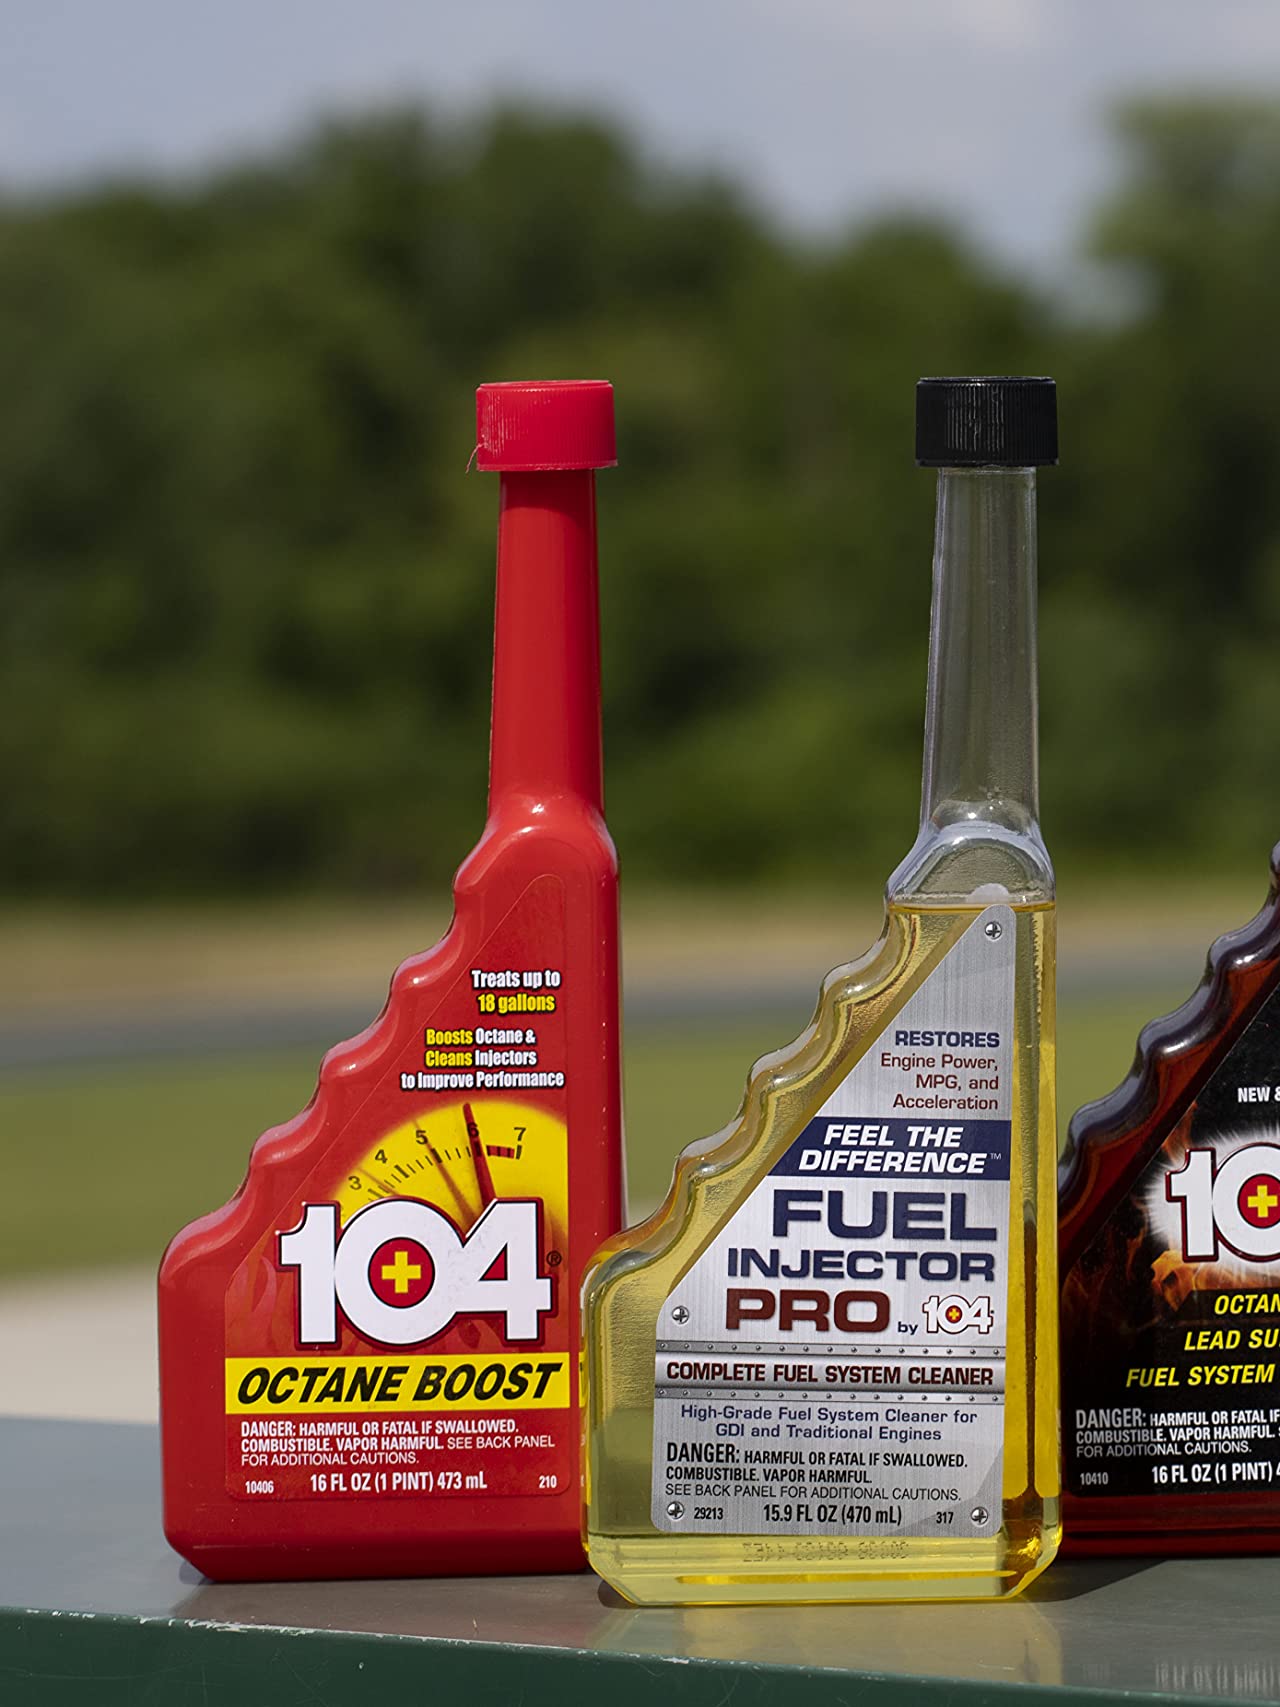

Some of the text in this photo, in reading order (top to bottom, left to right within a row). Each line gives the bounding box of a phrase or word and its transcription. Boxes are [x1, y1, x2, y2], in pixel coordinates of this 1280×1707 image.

[471, 970, 561, 990] Treats up to
[477, 994, 556, 1014] 18 gallons
[426, 1028, 536, 1045] Boosts Octane &
[895, 1030, 1000, 1048] RESTORES
[425, 1050, 537, 1067] Cleans Injectors
[881, 1053, 999, 1071] Engine Power,
[401, 1071, 565, 1090] to Improve Performance
[916, 1075, 999, 1091] MPG, and
[893, 1095, 998, 1110] Acceleration
[1237, 1087, 1271, 1102] NEW
[823, 1124, 964, 1147] FEEL THE
[348, 1122, 527, 1190] 3 4 5 6 7
[772, 1188, 997, 1241] FUEL
[727, 1247, 996, 1282] INJECTOR
[725, 1288, 891, 1333] PRO
[897, 1321, 919, 1336] by
[1184, 1330, 1240, 1351] LEAD
[237, 1362, 563, 1404] OCTANE BOOST
[666, 1361, 994, 1386] COMPLETE FUEL SYSTEM CLEANER
[1125, 1367, 1180, 1388] FUEL
[1187, 1364, 1276, 1386] SYSTEM
[681, 1404, 978, 1424] High-Grade Fuel System Cleaner for
[1076, 1408, 1147, 1429] DANGER:
[1150, 1411, 1210, 1427] HARMFUL
[1211, 1411, 1229, 1425] OR
[1231, 1410, 1267, 1425] FATAL
[1269, 1409, 1280, 1423] IF
[241, 1418, 519, 1437] DANGER: HARMFUL OR FATAL IF SWALLOWED.
[715, 1423, 942, 1443] GDI and Traditional Engines
[1076, 1428, 1167, 1444] COMBUSTIBLE.
[1169, 1427, 1211, 1441] VAPOR
[1213, 1425, 1276, 1440] HARMFUL.
[241, 1434, 556, 1453] COMBUSTIBLE. VAPOR HARMFUL. SEE BACK PANEL
[1076, 1439, 1252, 1458] FOR ADDITIONAL CAUTIONS.
[241, 1451, 420, 1466] FOR ADDITIONAL CAUTIONS.
[666, 1442, 968, 1468] DANGER: HARMFUL OR FATAL IF SWALLOWED.
[244, 1471, 557, 1494] 10406 16 FL OZ (1 PINT) 473 mL 210
[666, 1466, 873, 1484] COMBUSTIBLE. VAPOR HARMFUL.
[1080, 1471, 1109, 1486] 10410
[1151, 1466, 1168, 1484] 16
[1171, 1465, 1189, 1483] FL
[1191, 1464, 1212, 1482] OZ
[1214, 1464, 1229, 1483] (1
[1231, 1462, 1273, 1482] PINT)
[665, 1484, 962, 1502] SEE BACK PANEL FOR ADDITIONAL CAUTIONS.
[693, 1504, 954, 1525] 29213 15.9 FL OZ (470 mL) 317
